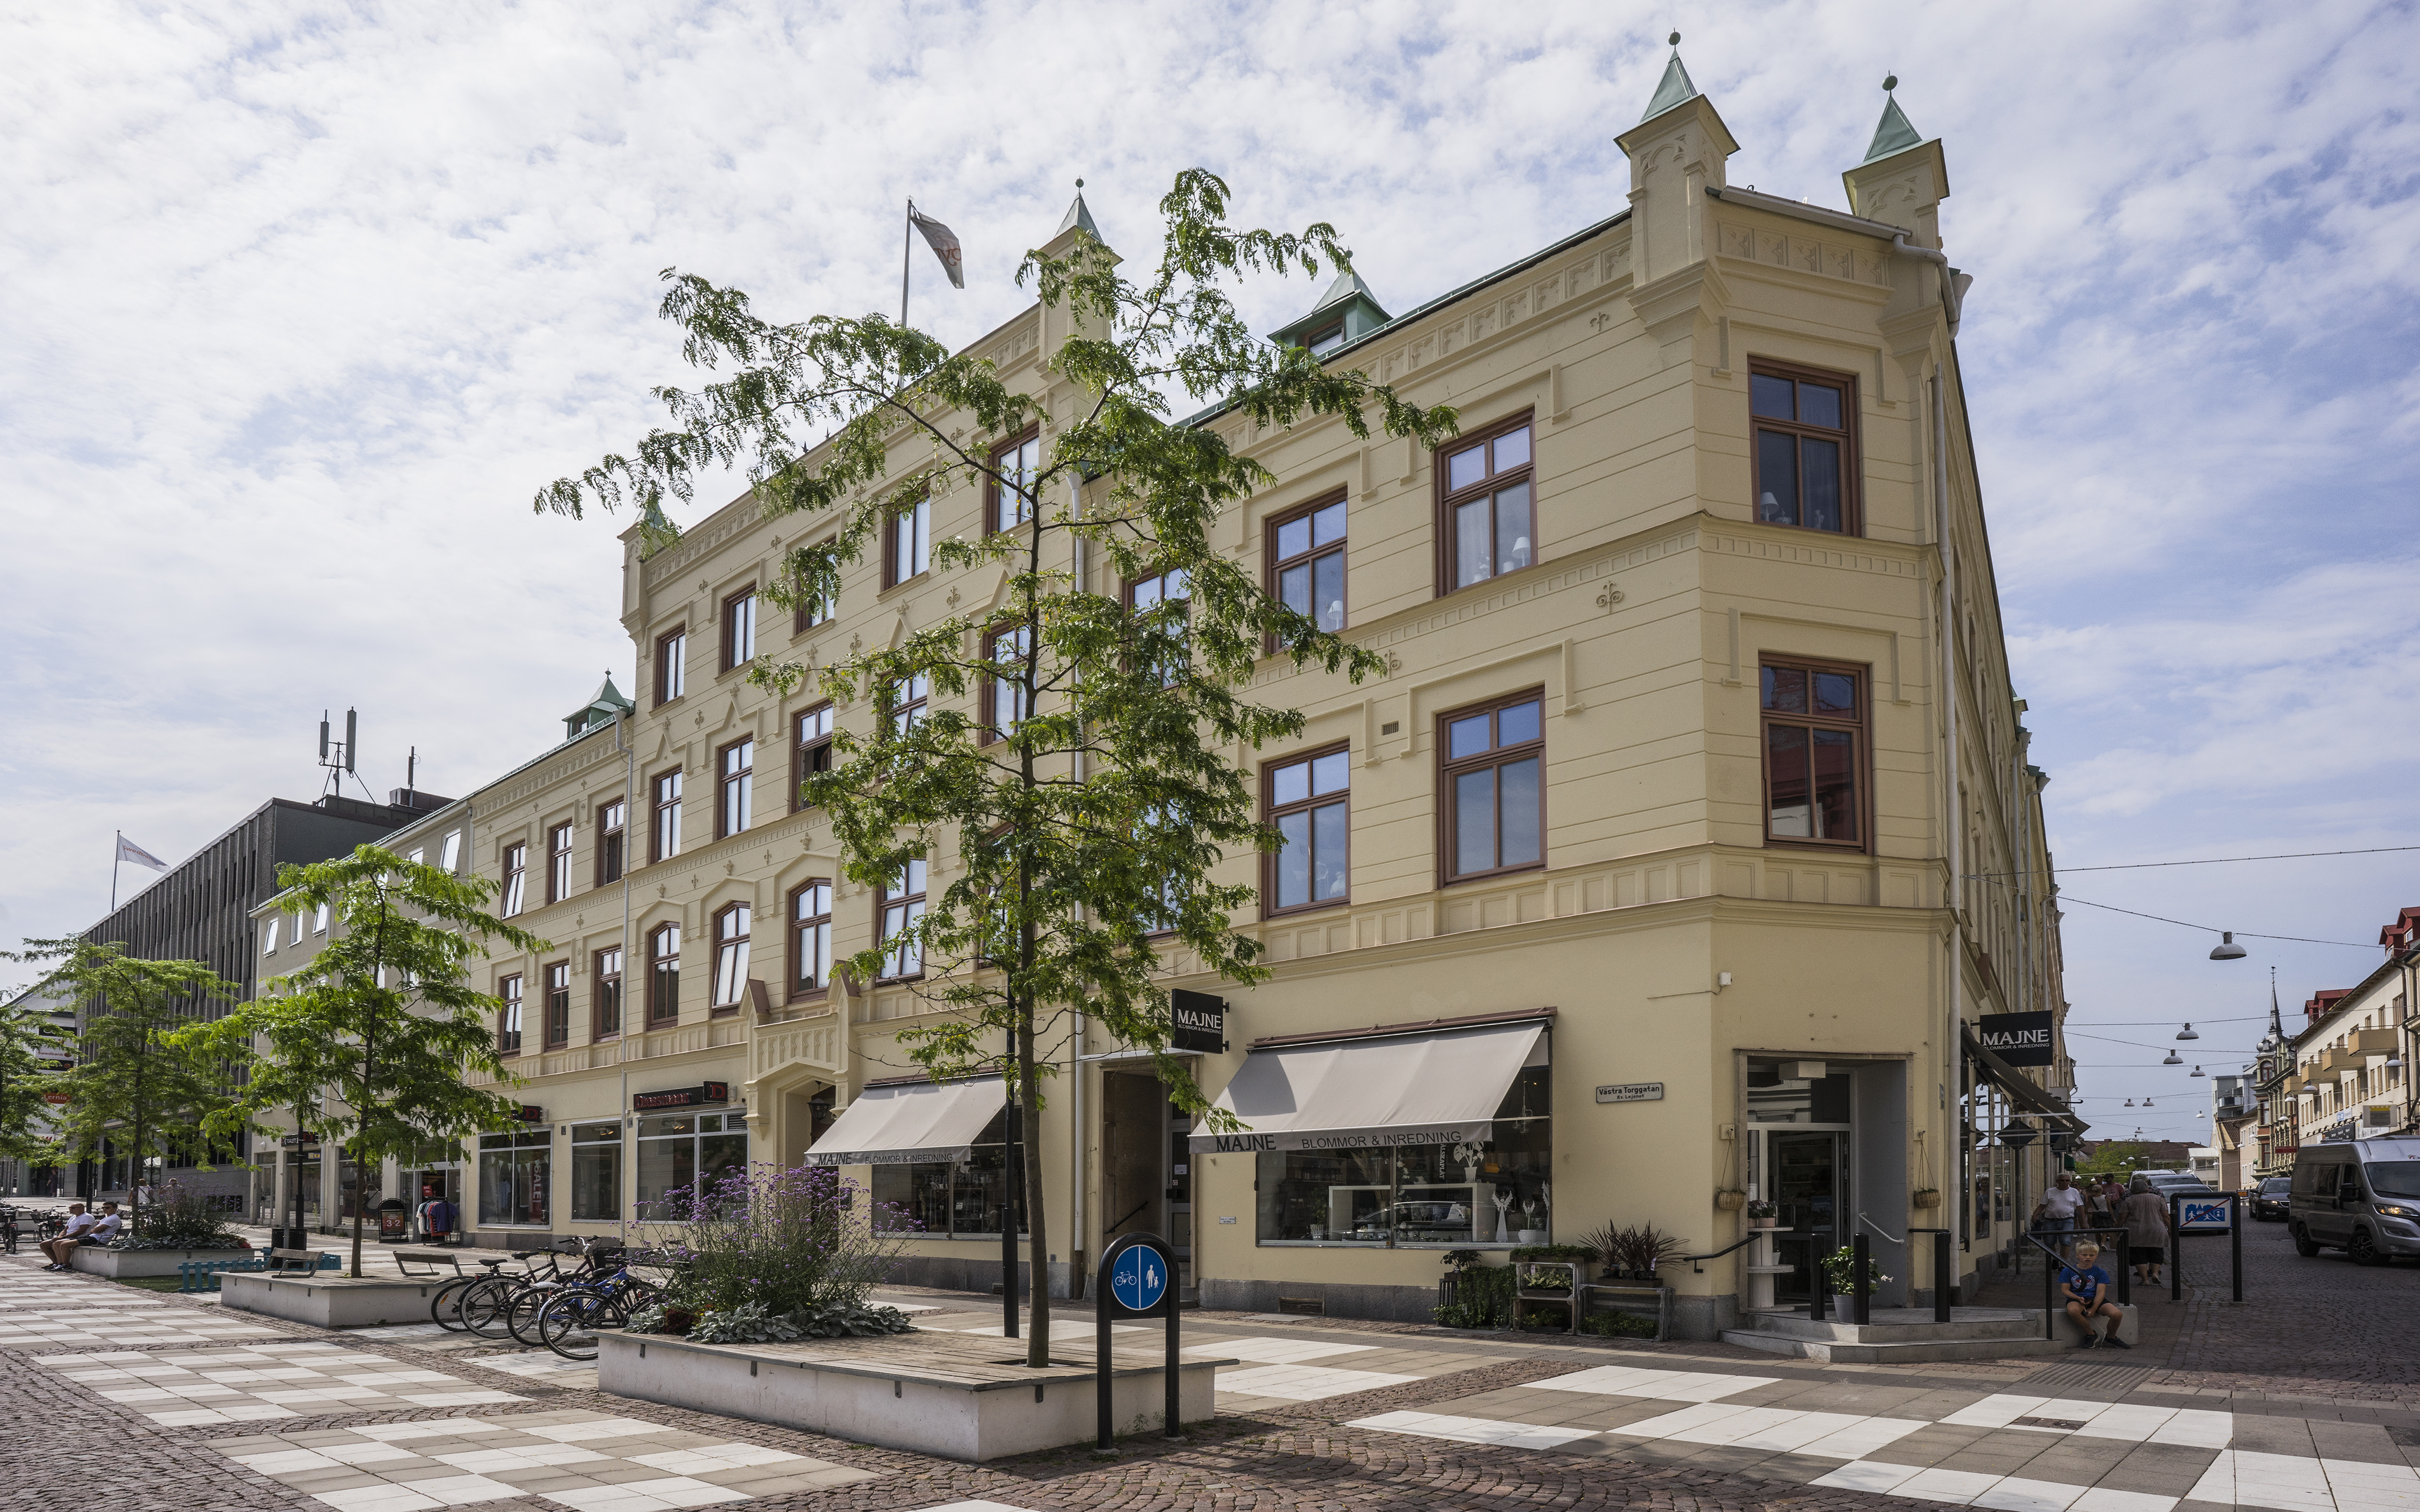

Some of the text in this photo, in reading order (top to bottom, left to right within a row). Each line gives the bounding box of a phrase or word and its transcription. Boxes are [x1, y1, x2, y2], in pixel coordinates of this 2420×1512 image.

[122, 845, 154, 861] Swedban
[1177, 1009, 1222, 1029] MAJNE
[1982, 1029, 2049, 1046] MAJNE
[710, 1084, 726, 1099] D
[1624, 1086, 1660, 1094] Torggatan
[635, 1093, 691, 1108] Dressmann
[1215, 1131, 1462, 1152] MAJNE BLOMMOR & INREDNING
[818, 1153, 953, 1166] MAJNE BLOMMOR & INREDNING
